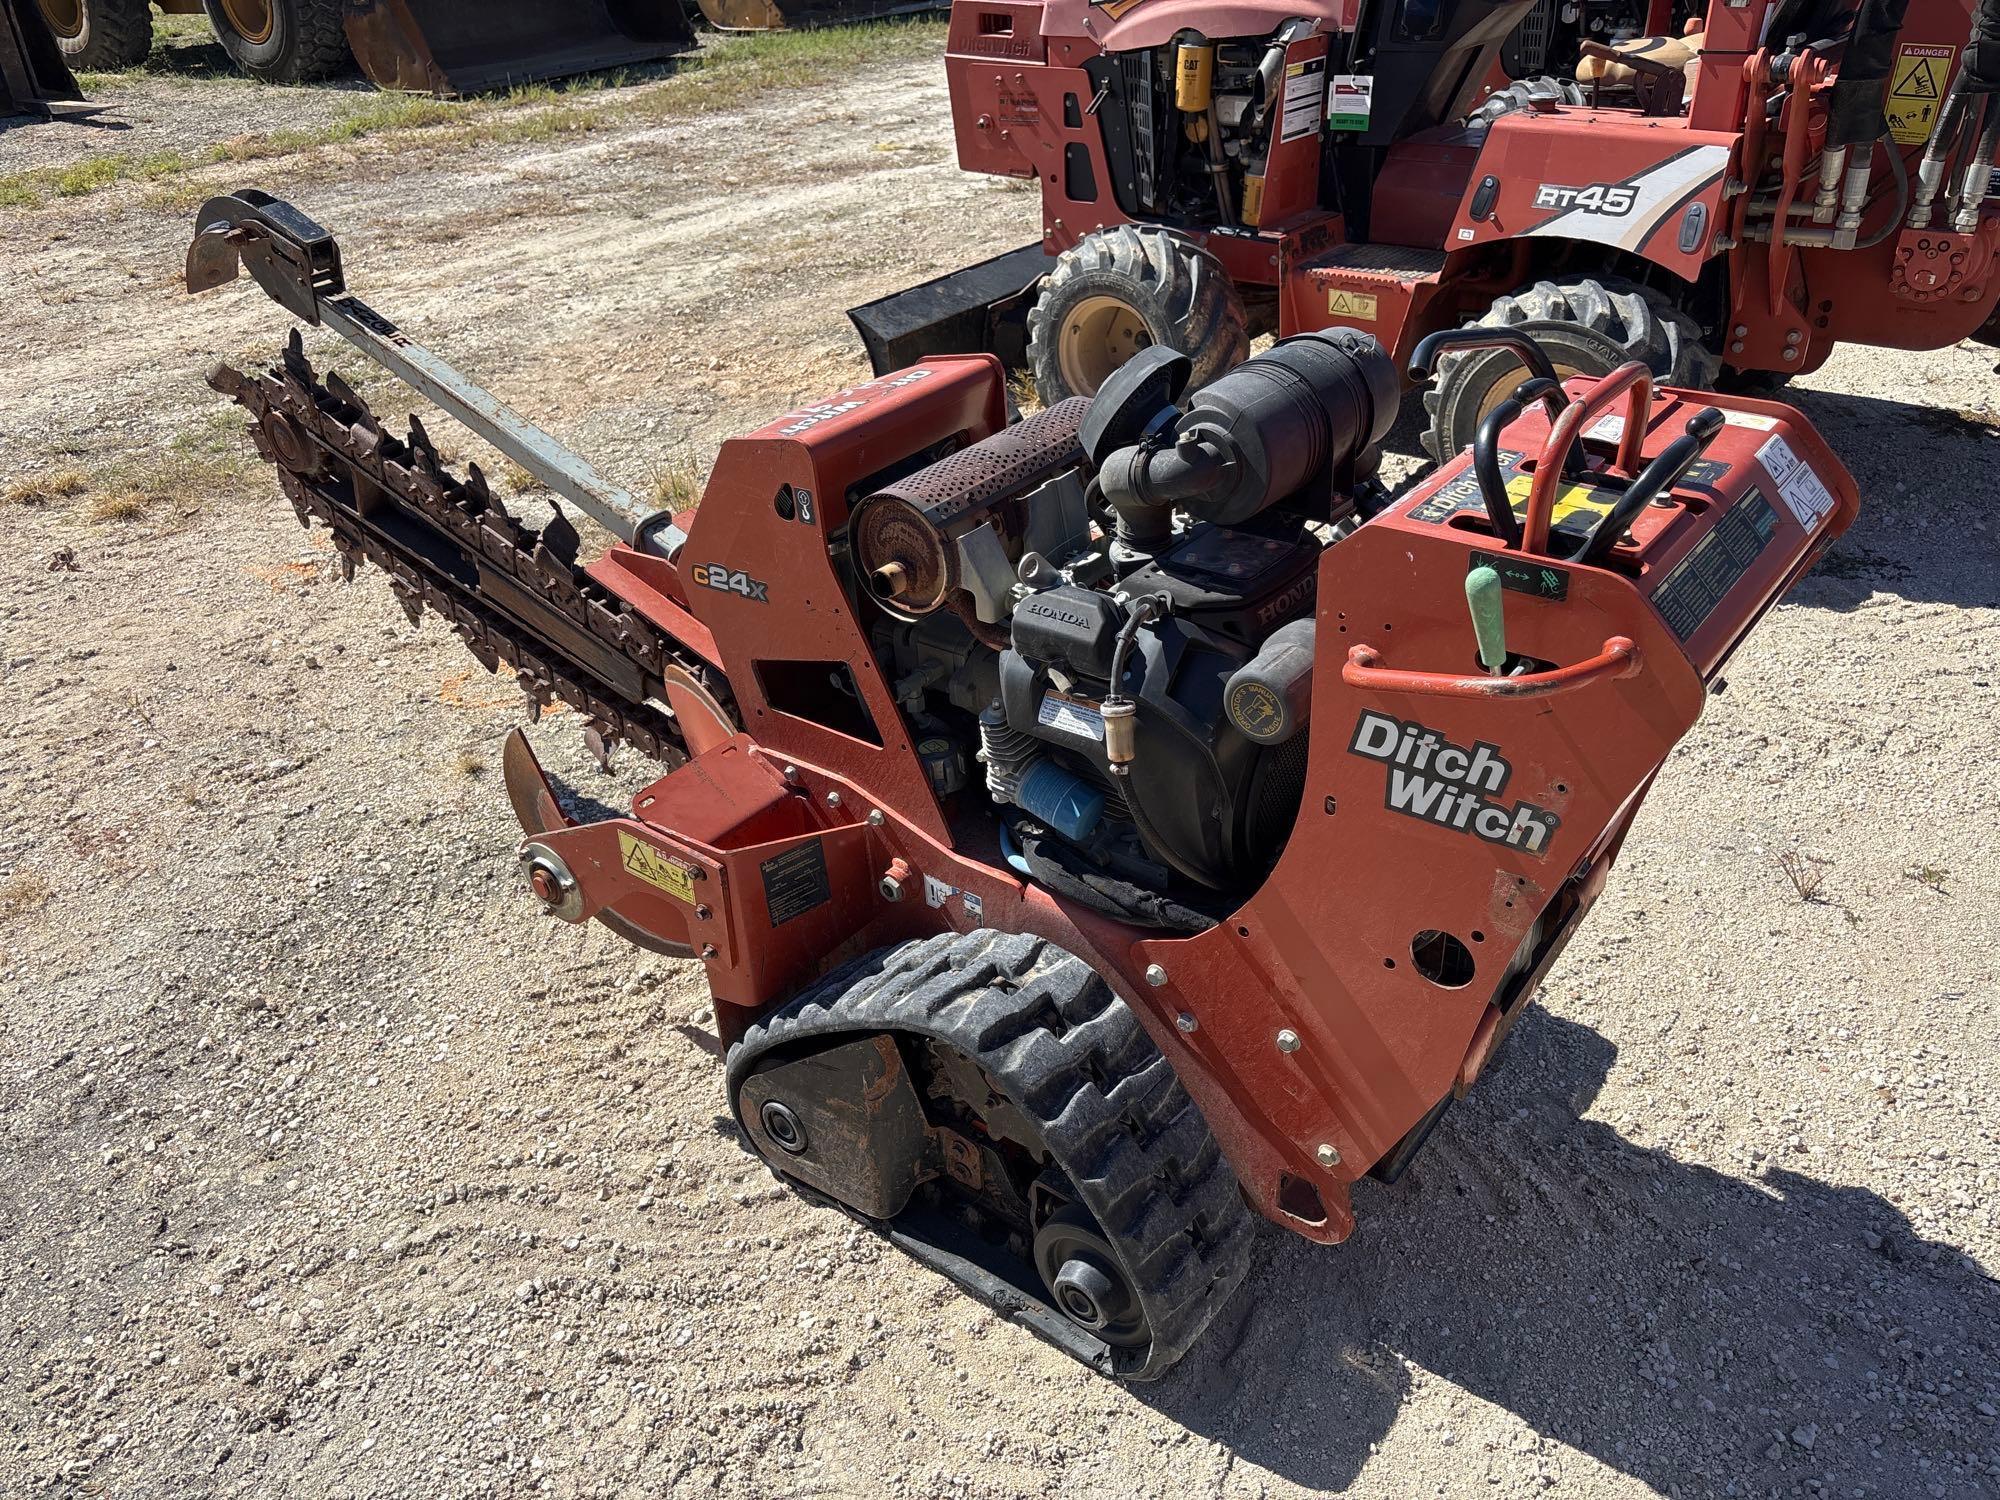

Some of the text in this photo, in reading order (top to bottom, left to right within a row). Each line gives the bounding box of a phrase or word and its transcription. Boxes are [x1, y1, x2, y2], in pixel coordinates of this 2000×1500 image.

[1184, 59, 1199, 71] CAT
[1913, 48, 1950, 57] DANGER
[1536, 185, 1634, 214] RT45
[338, 298, 413, 348] DANGER
[1434, 479, 1480, 511] Ditch
[693, 565, 767, 601] C24X
[1256, 575, 1316, 626] HOND
[1025, 603, 1091, 630] HONDA
[1248, 685, 1275, 703] MANUAL
[1262, 715, 1281, 734] INSIDE
[1353, 714, 1507, 792] Ditch
[1389, 768, 1549, 851] Witch
